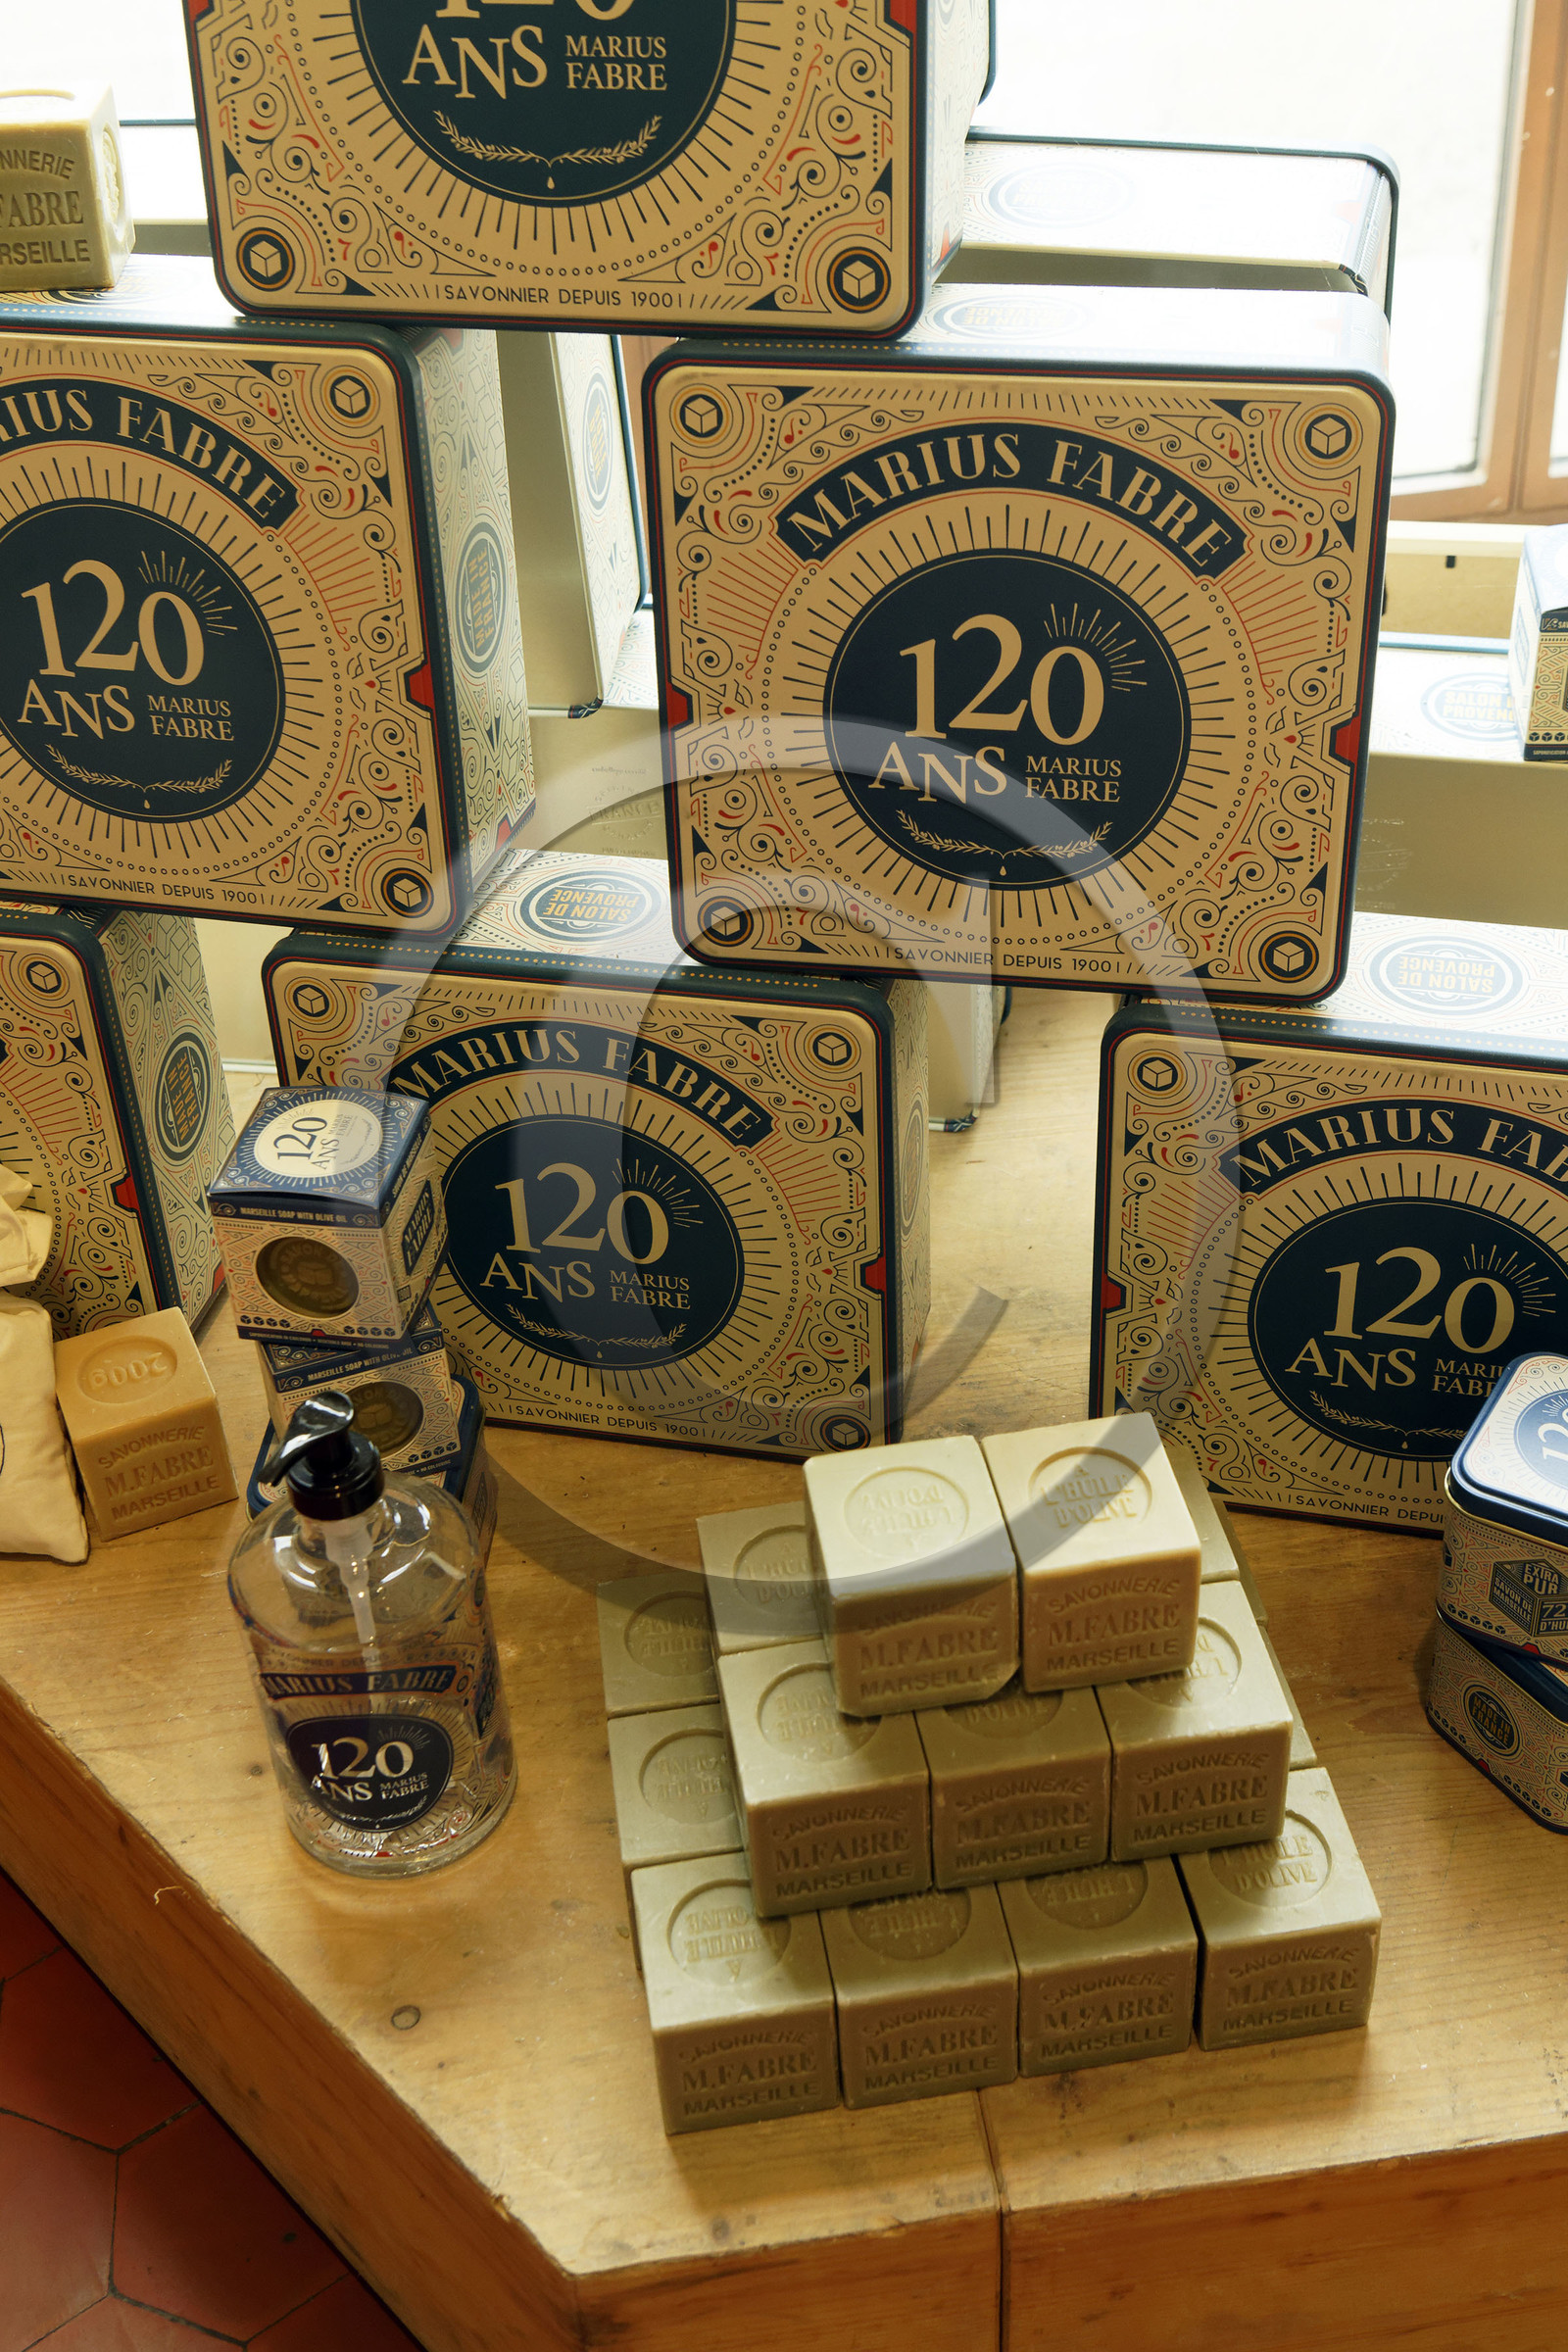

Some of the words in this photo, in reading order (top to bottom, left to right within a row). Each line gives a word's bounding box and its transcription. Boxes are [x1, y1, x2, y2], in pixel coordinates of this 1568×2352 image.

[402, 24, 548, 99] ANS
[565, 35, 667, 59] MARIUS
[565, 62, 668, 91] FABRE
[445, 284, 550, 304] SAVONNIER
[559, 288, 622, 307] DEPUIS
[631, 291, 674, 309] 1900
[117, 395, 286, 519] FABRE
[787, 433, 1021, 553] MARIUS
[1047, 439, 1233, 567] FABRE
[21, 560, 205, 686] 120
[900, 613, 1104, 746] 120
[17, 678, 136, 740] ANS
[147, 695, 231, 717] MARIUS
[149, 714, 235, 742] FABRE
[867, 741, 1007, 805] ANS
[1026, 755, 1122, 777] MARIUS
[1025, 776, 1122, 803] FABRE
[68, 874, 156, 894] SAVONNIER
[162, 883, 215, 900] DEPUIS
[221, 889, 258, 905] 1900
[550, 888, 641, 909] PROVENCE
[543, 901, 566, 916] DE
[570, 903, 632, 922] SALON
[895, 947, 994, 966] SAVONNIER
[1003, 954, 1062, 970] DEPUIS
[1072, 957, 1111, 973] 1900
[1399, 956, 1496, 978] PROVENCE
[1397, 970, 1421, 987] DE
[1429, 971, 1494, 994] SALON
[167, 1066, 179, 1091] IN
[177, 1052, 200, 1128] FRANCE
[392, 1029, 580, 1100] MARIUS
[603, 1037, 762, 1141] FABRE
[172, 1090, 189, 1141] MADE
[272, 1116, 328, 1161] 120
[311, 1138, 340, 1170] ANS
[1229, 1107, 1455, 1188] MARIUS
[240, 1206, 276, 1218] MARSEILLE
[278, 1208, 295, 1219] SOAP
[315, 1211, 335, 1222] OLIVE
[495, 1162, 669, 1265] 120
[479, 1251, 596, 1303] ANS
[610, 1269, 690, 1291] MARIUS
[610, 1286, 691, 1310] FABRE
[1324, 1247, 1515, 1353] 120
[307, 1365, 344, 1381] MARSEILLE
[345, 1361, 363, 1372] SOAP
[364, 1355, 380, 1367] WITH
[1284, 1337, 1417, 1392] ANS
[515, 1404, 600, 1425] SAVONNIER
[607, 1416, 658, 1432] DEPUIS
[664, 1423, 699, 1437] 1900
[98, 1425, 206, 1469] SAVONNERIE
[103, 1446, 215, 1499] M.FABRE
[111, 1474, 220, 1521] MARSEILLE
[1296, 1494, 1390, 1517] SAVONNIER
[1523, 1562, 1560, 1585] EXTRA
[1523, 1575, 1559, 1595] PUR
[1048, 1577, 1180, 1614] SAVONNERIE
[1493, 1588, 1532, 1624] MARSEILLE
[1494, 1577, 1522, 1603] SAVON
[1521, 1598, 1533, 1614] DE
[1048, 1603, 1181, 1647] M.FABRE
[1047, 1638, 1179, 1671] MARSEILLE
[263, 1675, 354, 1695] MARIUS
[367, 1667, 455, 1691] FABRE
[858, 1663, 999, 1697] MARSEILLE
[1471, 1704, 1509, 1745] FRANCE
[1473, 1694, 1499, 1727] MADE
[311, 1736, 414, 1780] 120
[310, 1775, 373, 1803] ANS
[380, 1772, 429, 1790] MARIUS
[381, 1780, 430, 1800] FABRE
[1136, 1775, 1268, 1817] M.FABRE
[1134, 1808, 1267, 1841] MARSEILLE
[774, 1828, 910, 1872] M.FABRE
[774, 1863, 912, 1898] MARSEILLE
[1234, 1861, 1318, 1891] D'OLIVE
[1223, 1998, 1352, 2031] MARSEILLE
[865, 2024, 999, 2066] M.FABRE
[1041, 2024, 1174, 2057] MARSEILLE
[683, 2051, 817, 2092] M.FABRE
[865, 2057, 998, 2089] MARSEILLE
[683, 2080, 819, 2115] MARSEILLE
